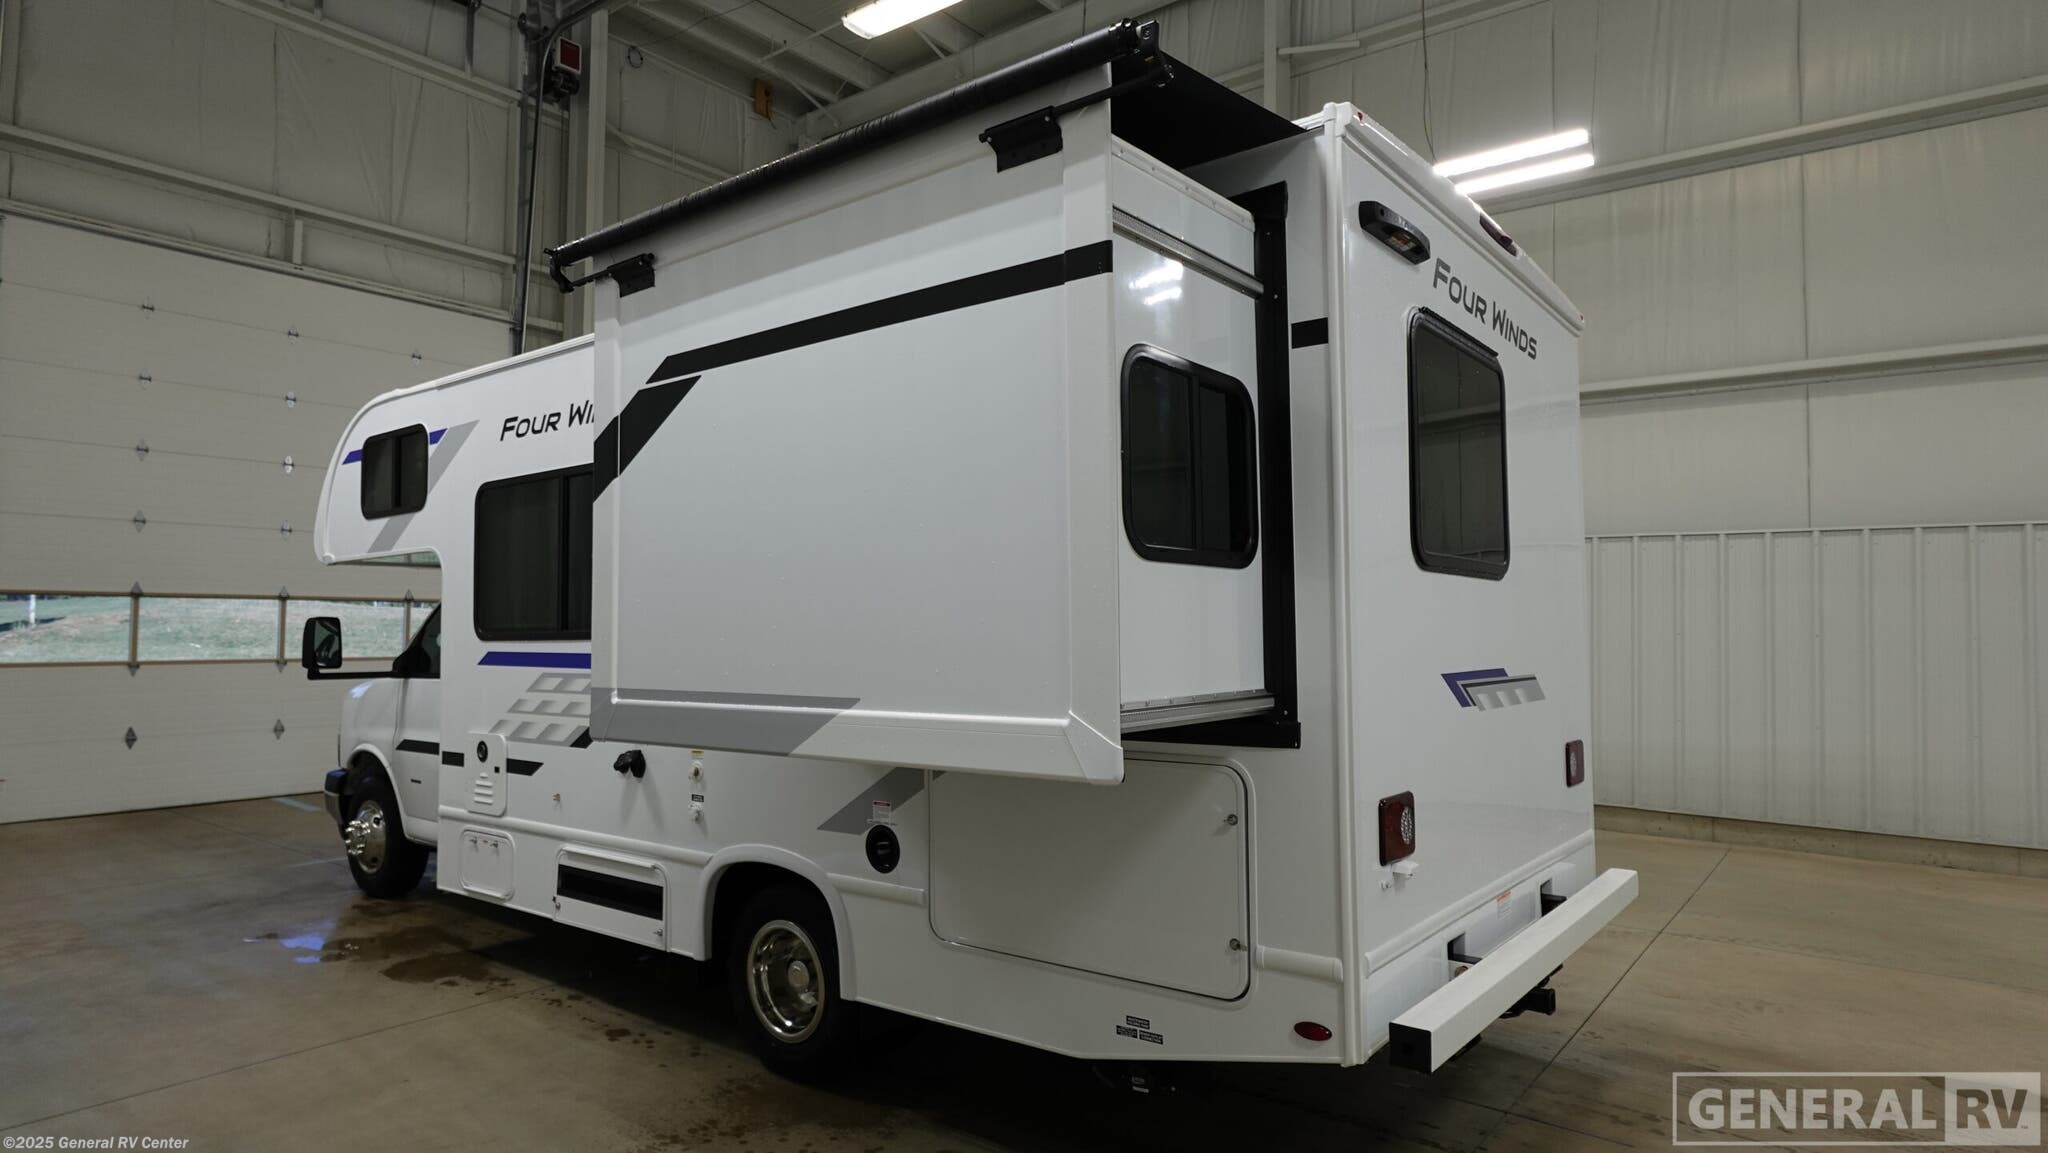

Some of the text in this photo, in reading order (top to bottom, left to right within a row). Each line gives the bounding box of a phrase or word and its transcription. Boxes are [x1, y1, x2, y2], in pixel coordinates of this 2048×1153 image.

[1433, 258, 1537, 360] FOUR WINDS
[500, 400, 594, 441] FOUR WI
